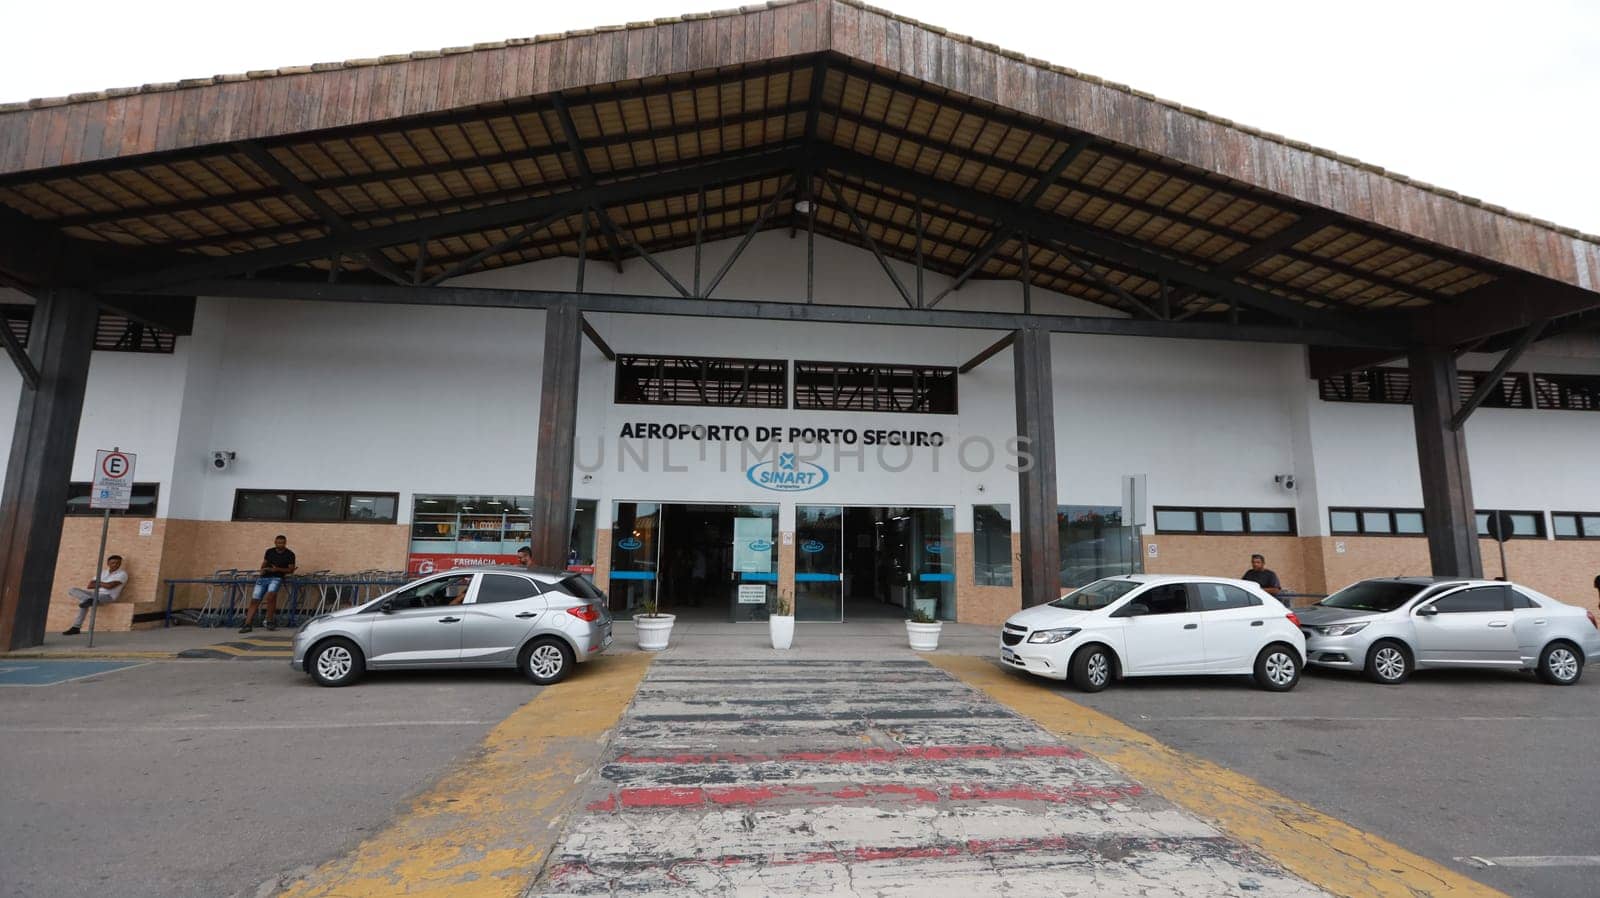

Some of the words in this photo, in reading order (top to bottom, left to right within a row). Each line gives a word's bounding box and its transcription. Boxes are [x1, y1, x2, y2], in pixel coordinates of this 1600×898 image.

[620, 422, 749, 442] AEROPORTO
[756, 426, 782, 443] DE
[789, 428, 857, 445] PORTO
[863, 430, 944, 447] SEGURO
[111, 458, 121, 473] E
[760, 471, 816, 485] SINART
[453, 557, 496, 566] FARMÁCIA
